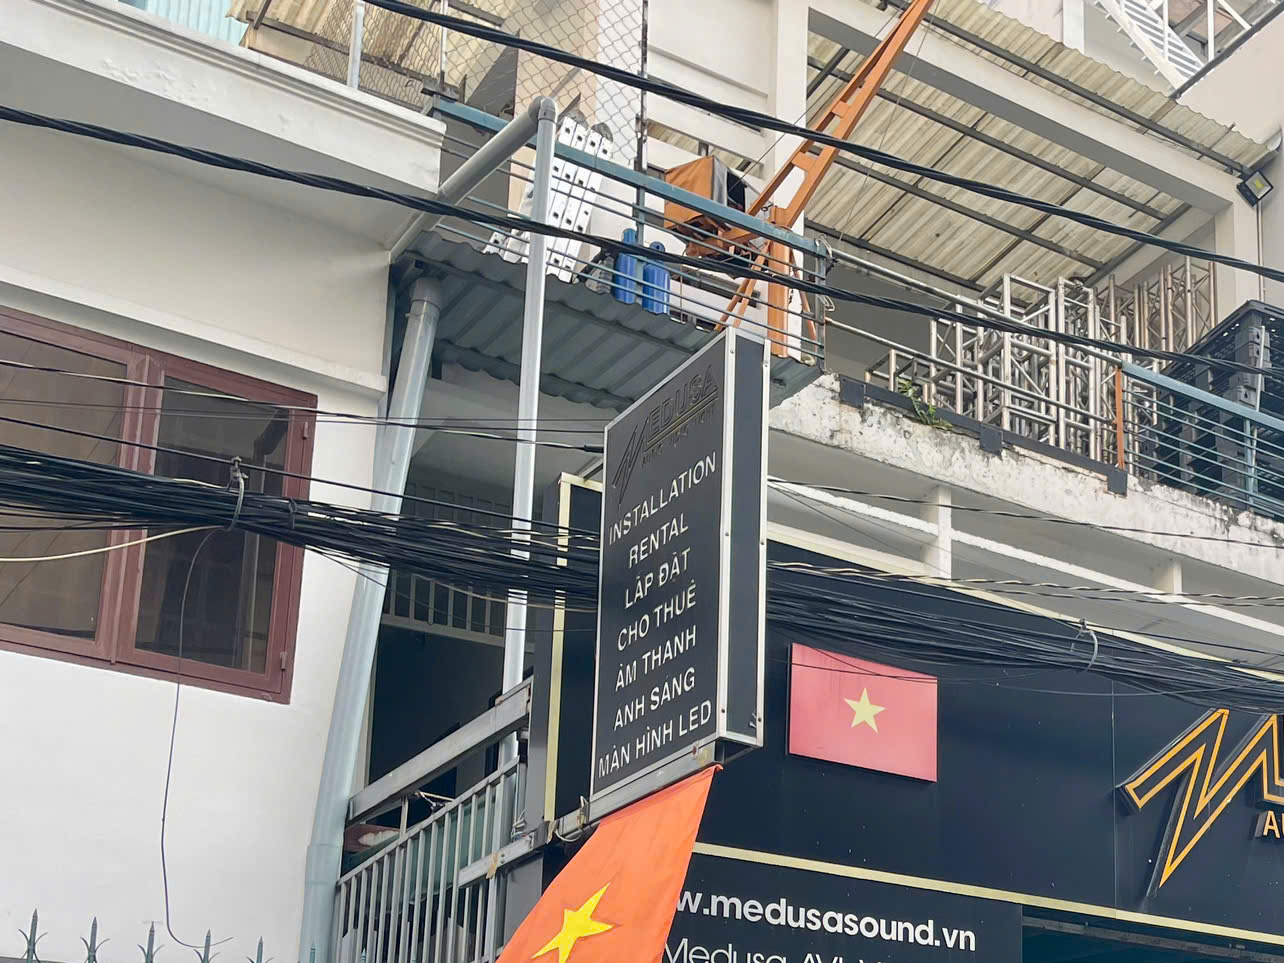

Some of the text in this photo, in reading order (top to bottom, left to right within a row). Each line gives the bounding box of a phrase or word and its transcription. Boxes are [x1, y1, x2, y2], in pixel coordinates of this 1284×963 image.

[609, 451, 717, 546] INSTALLATION
[628, 512, 689, 568] RENTAL
[618, 614, 650, 651] CHO
[642, 625, 697, 674] THANH
[679, 700, 712, 736] LED
